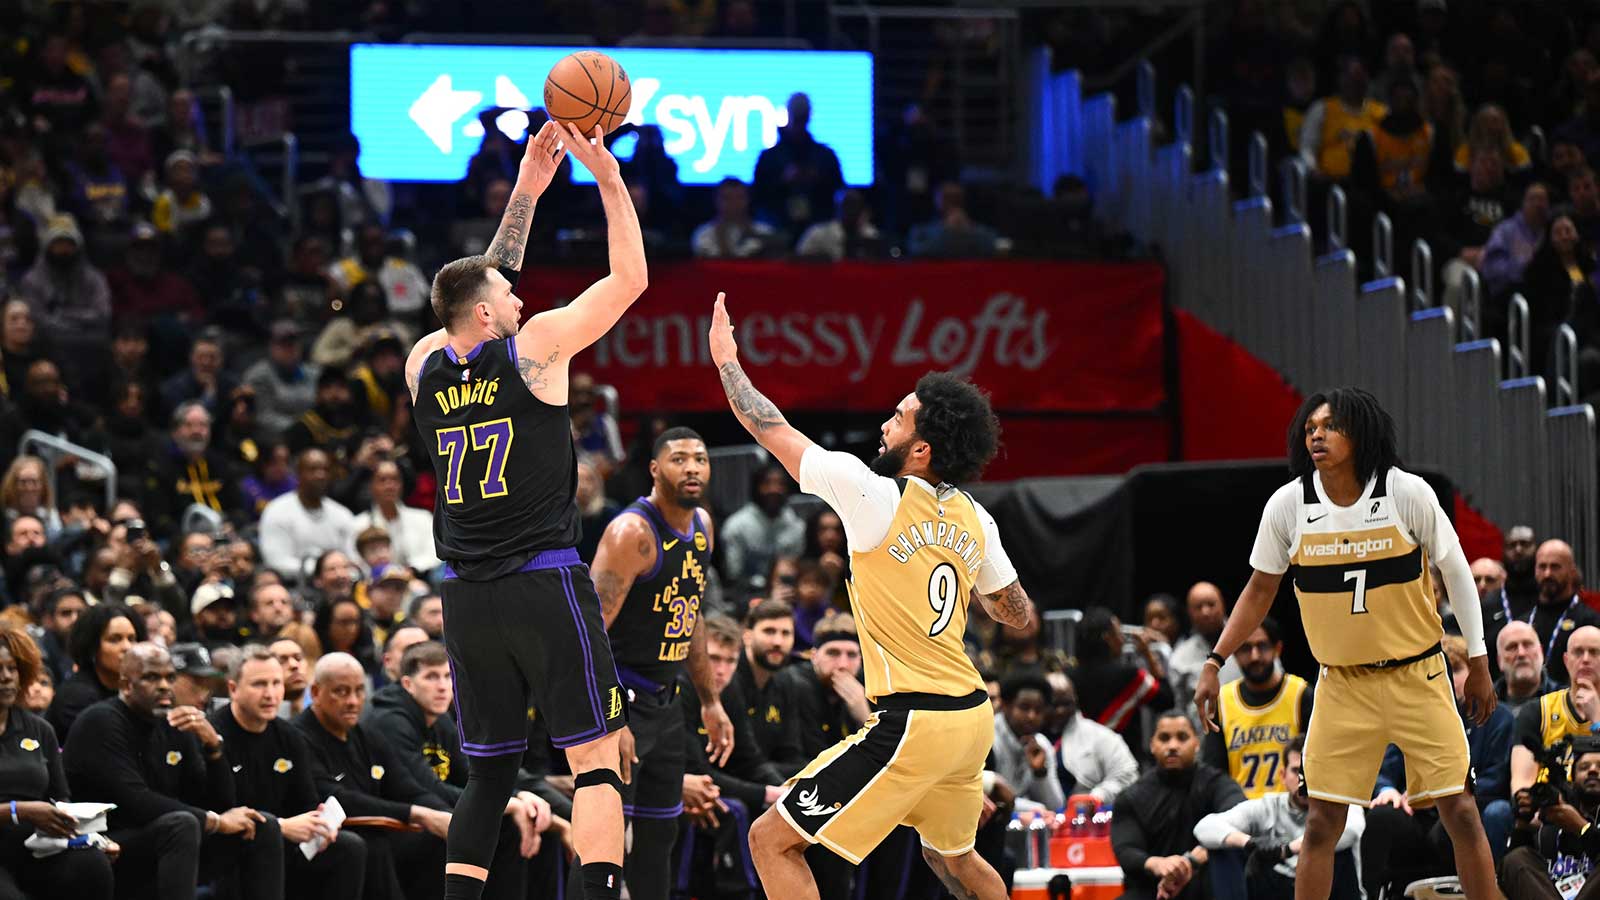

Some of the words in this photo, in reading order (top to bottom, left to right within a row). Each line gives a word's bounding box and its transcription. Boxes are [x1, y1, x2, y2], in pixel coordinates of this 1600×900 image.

[891, 291, 1055, 378] Lofts
[434, 377, 500, 416] DONČIĆ
[435, 417, 514, 505] 77
[1303, 537, 1393, 558] washington
[928, 562, 958, 637] 9
[1343, 569, 1369, 615] 7
[664, 594, 700, 638] 36
[1242, 751, 1280, 789] 77
